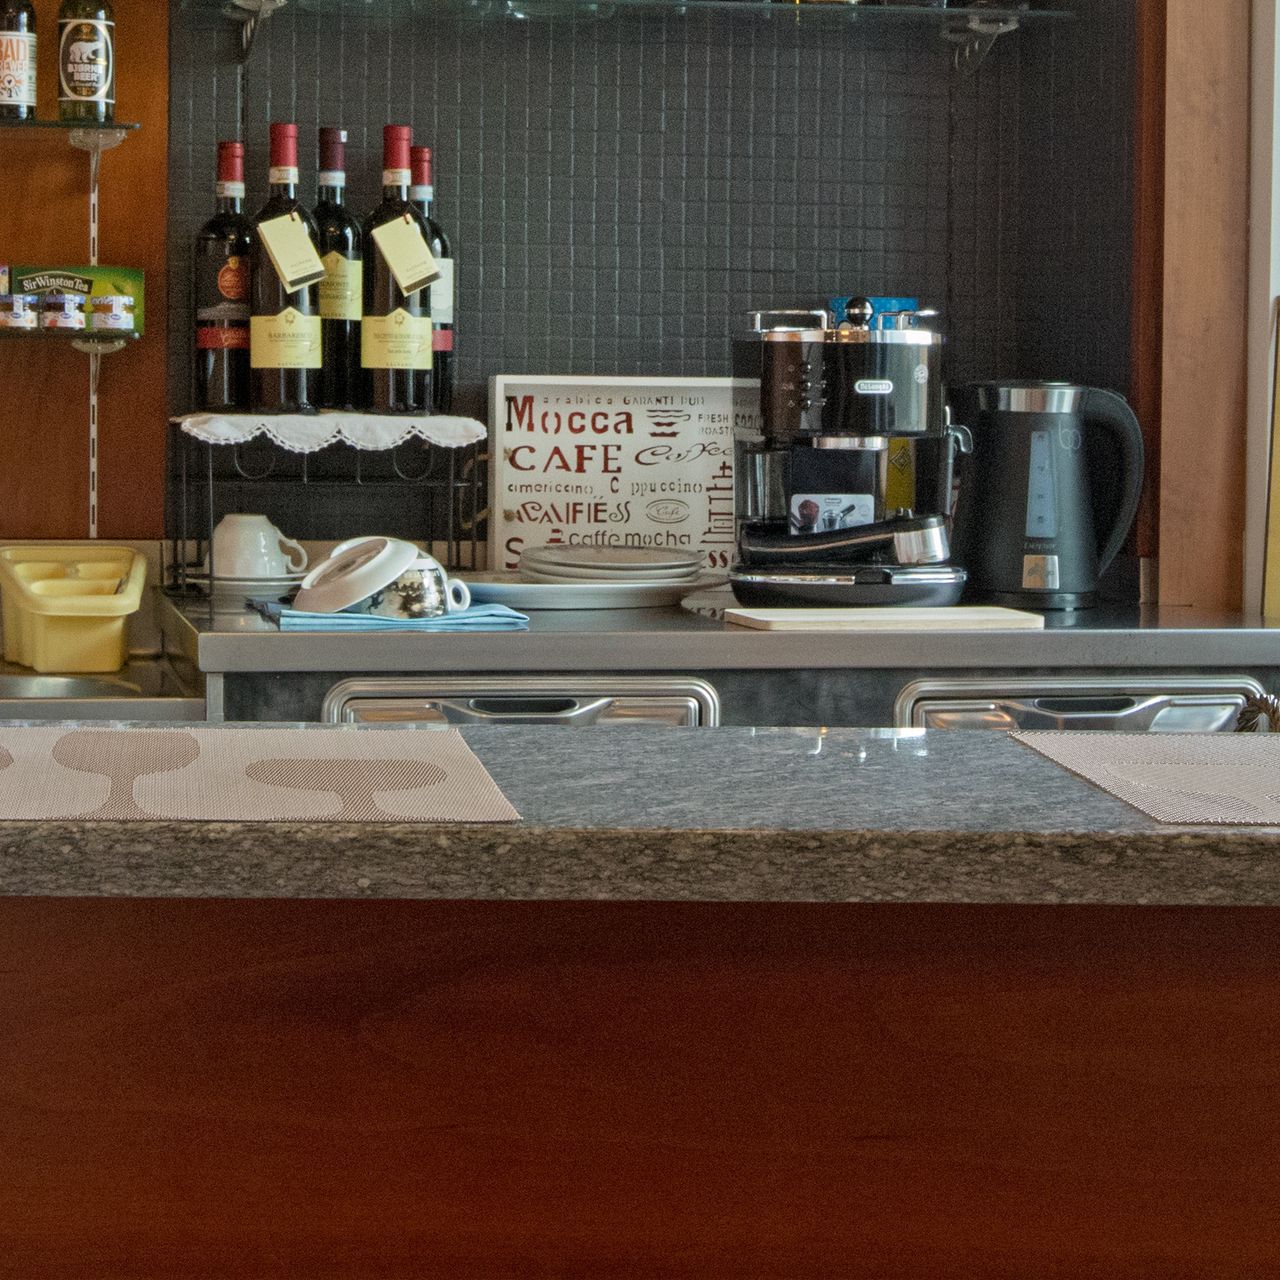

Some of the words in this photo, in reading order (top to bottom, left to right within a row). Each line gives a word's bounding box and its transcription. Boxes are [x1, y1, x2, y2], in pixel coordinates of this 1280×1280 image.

[505, 394, 634, 435] Mocca
[508, 444, 622, 474] CAFE
[624, 530, 692, 547] mocha
